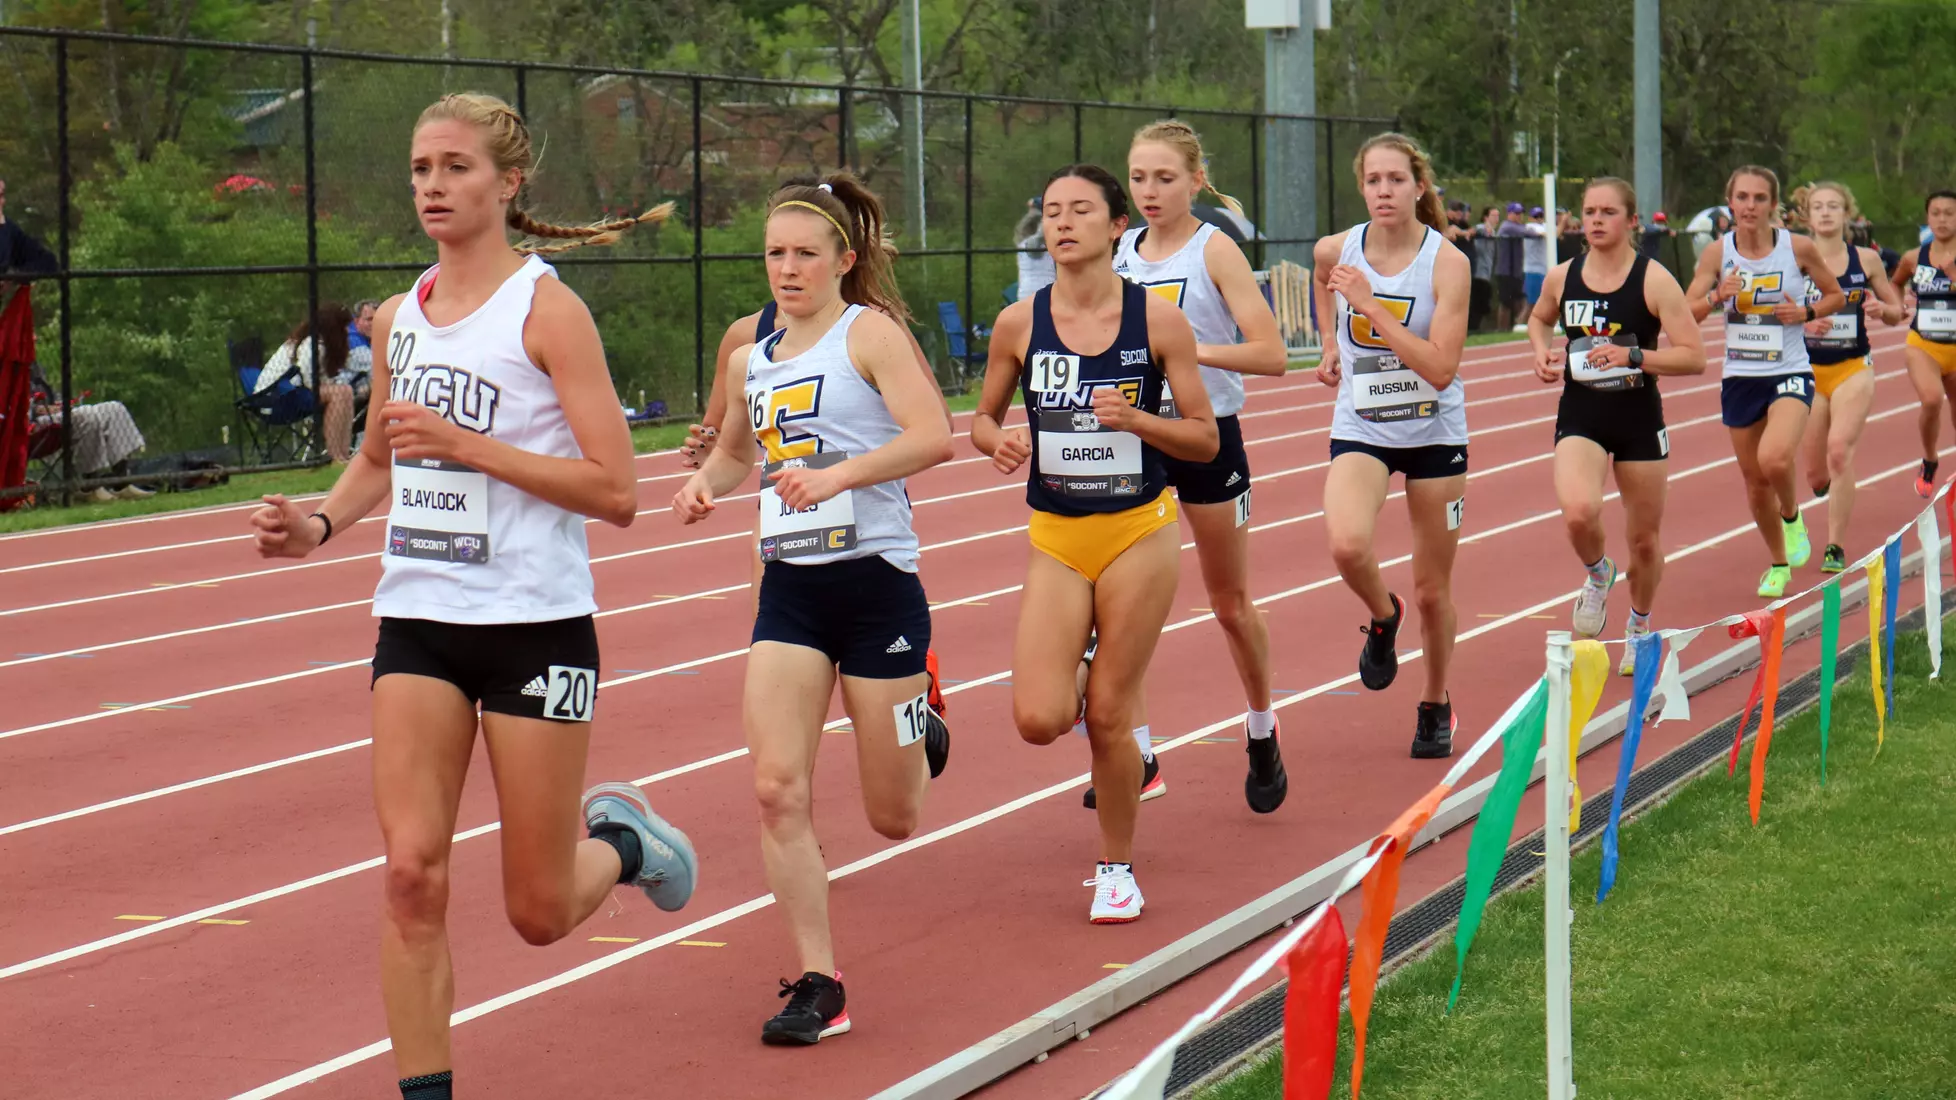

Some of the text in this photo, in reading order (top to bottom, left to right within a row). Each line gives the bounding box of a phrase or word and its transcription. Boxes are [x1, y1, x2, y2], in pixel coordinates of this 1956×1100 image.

[1568, 302, 1588, 325] 17
[390, 331, 416, 376] 20
[1120, 348, 1149, 367] SOCON
[1039, 356, 1070, 391] 19
[1369, 381, 1419, 396] RUSSUM
[747, 390, 766, 429] 16
[1418, 402, 1432, 417] C
[1061, 447, 1115, 461] GARCIA
[402, 488, 467, 512] BLAYLOCK
[409, 538, 448, 551] #SOCONTF
[453, 535, 481, 549] WCU
[780, 537, 819, 551] #SOCONTF
[827, 528, 847, 549] C
[885, 644, 912, 654] adidas
[520, 688, 548, 698] adida
[552, 670, 589, 719] 20
[903, 696, 926, 740] 16
